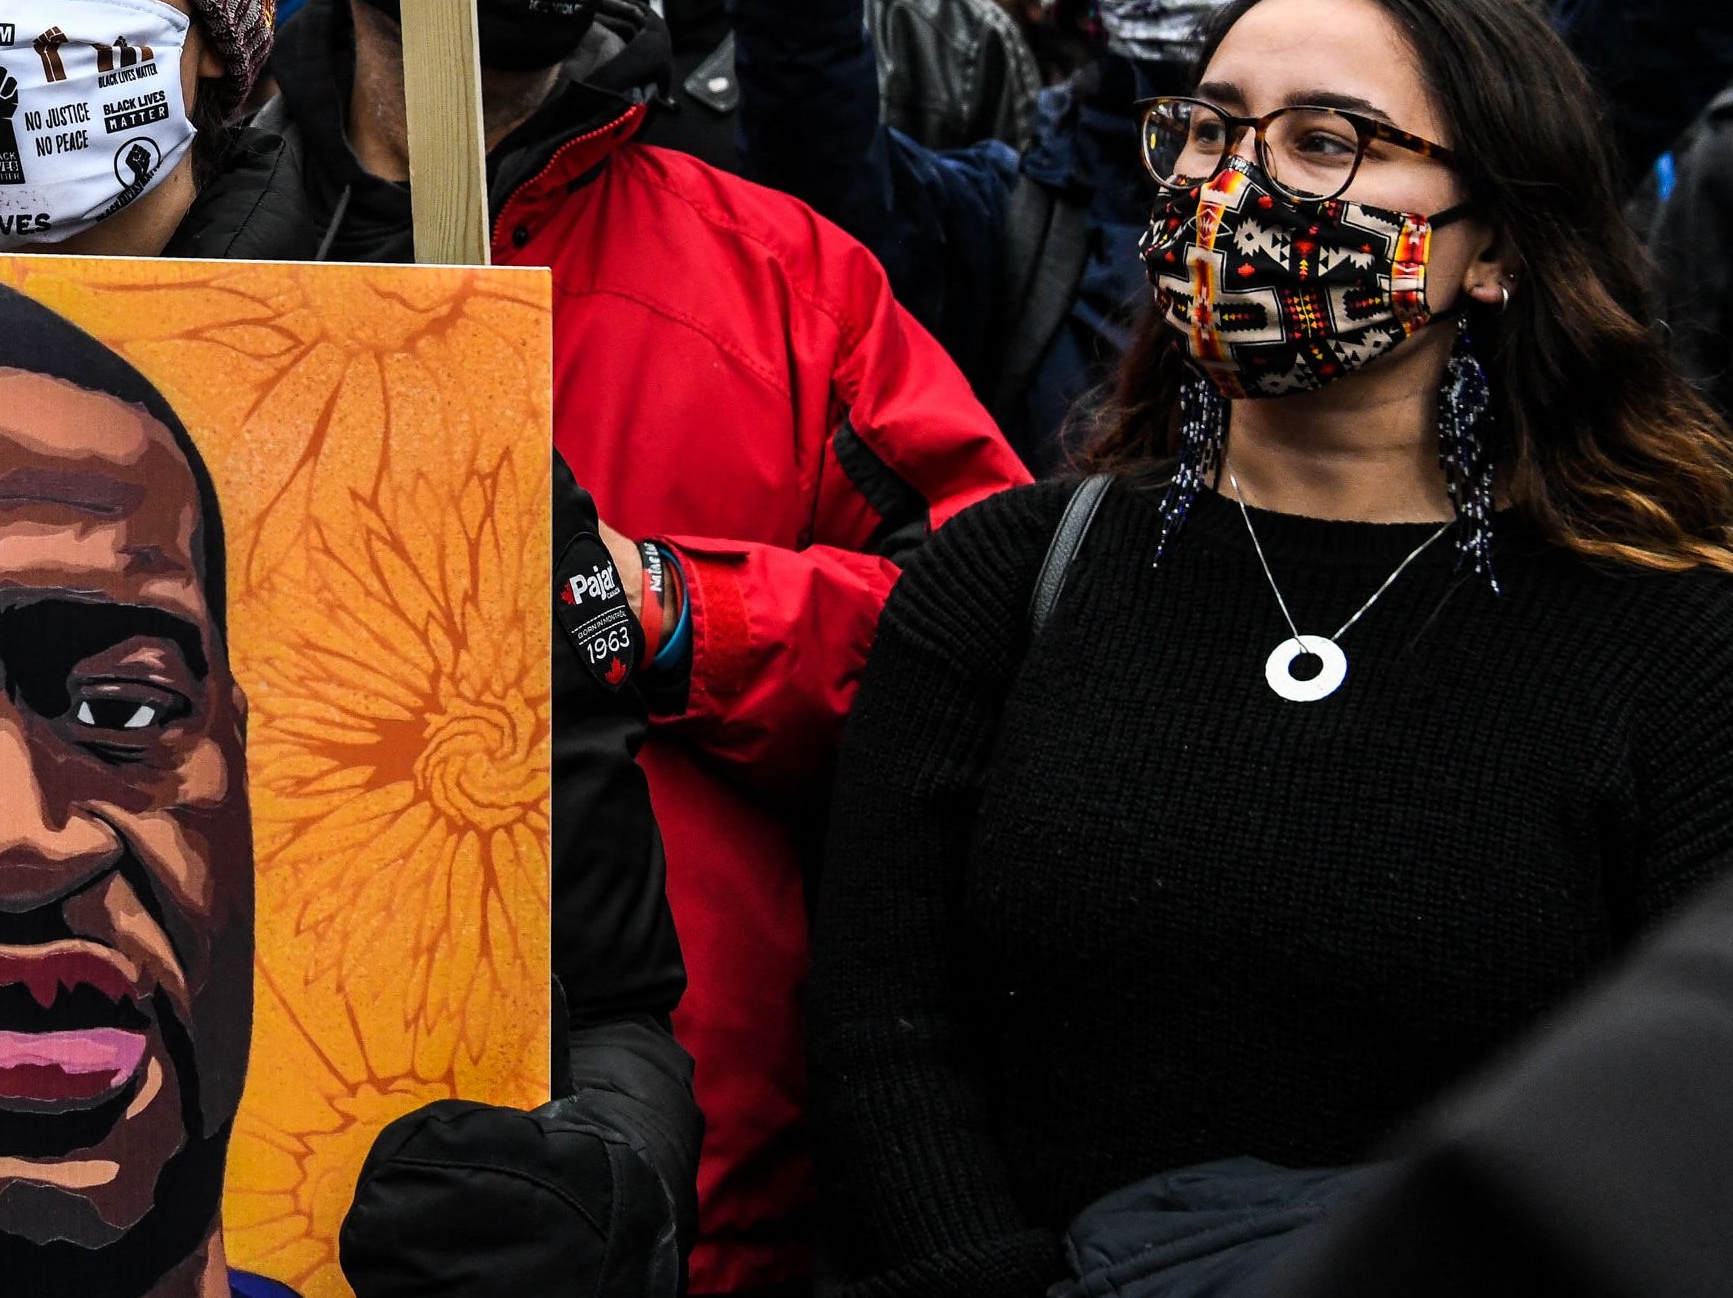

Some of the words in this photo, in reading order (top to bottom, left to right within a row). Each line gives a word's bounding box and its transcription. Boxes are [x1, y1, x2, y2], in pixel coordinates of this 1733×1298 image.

[98, 75, 118, 88] BLACK
[118, 69, 136, 84] LIVES
[136, 63, 158, 79] MATTER
[103, 98, 137, 115] BLACK
[138, 91, 165, 107] LIVES
[25, 111, 41, 131] NO
[46, 102, 90, 128] JUSTICE
[109, 107, 166, 130] MATTER
[36, 137, 53, 157] NO
[56, 130, 89, 154] PEACE
[569, 563, 615, 604] Pajar
[578, 624, 597, 639] BORN
[587, 627, 629, 663] 1963
